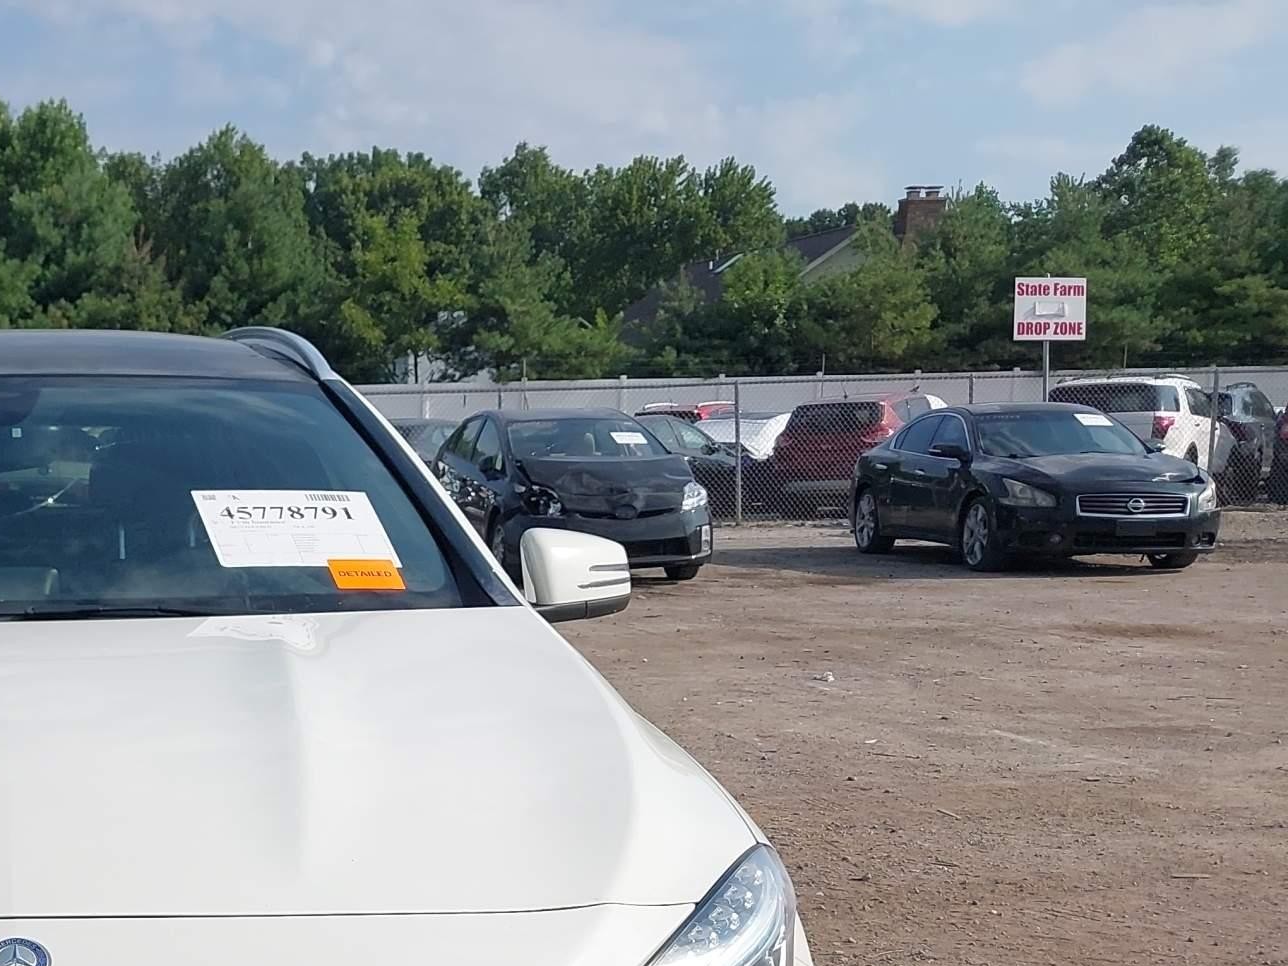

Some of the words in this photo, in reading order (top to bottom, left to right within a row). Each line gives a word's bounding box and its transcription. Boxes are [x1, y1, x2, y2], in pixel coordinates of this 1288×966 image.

[1017, 282, 1050, 297] State
[1053, 282, 1085, 297] Farm
[1017, 321, 1051, 336] DROP
[1053, 321, 1083, 336] ZONE
[220, 506, 355, 520] 45778791
